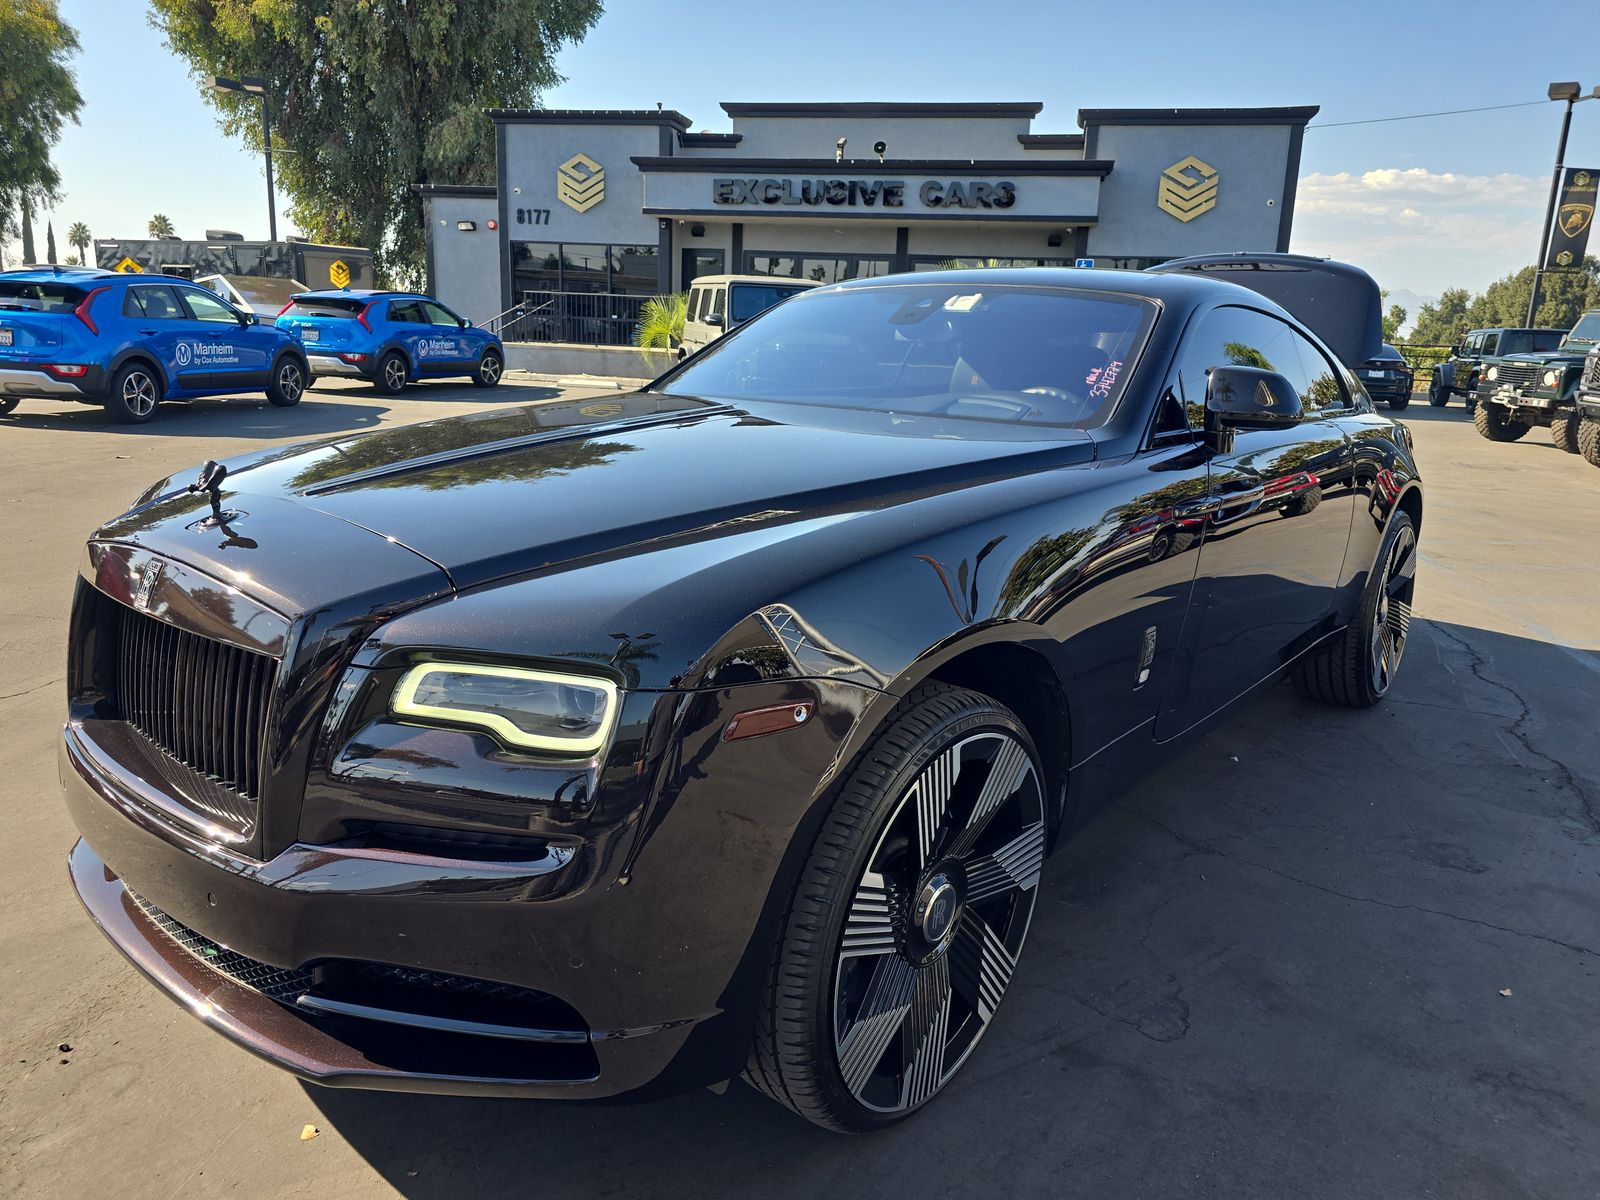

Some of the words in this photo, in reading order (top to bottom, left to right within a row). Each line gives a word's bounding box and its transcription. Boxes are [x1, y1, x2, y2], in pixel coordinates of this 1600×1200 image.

[713, 178, 905, 207] EXCLUSIVE
[919, 180, 1016, 209] CARS
[516, 207, 551, 225] 8177
[193, 342, 234, 355] Manheim
[429, 339, 456, 349] Manheim
[194, 356, 202, 366] by
[201, 356, 212, 364] Cox
[213, 356, 239, 364] Automotive
